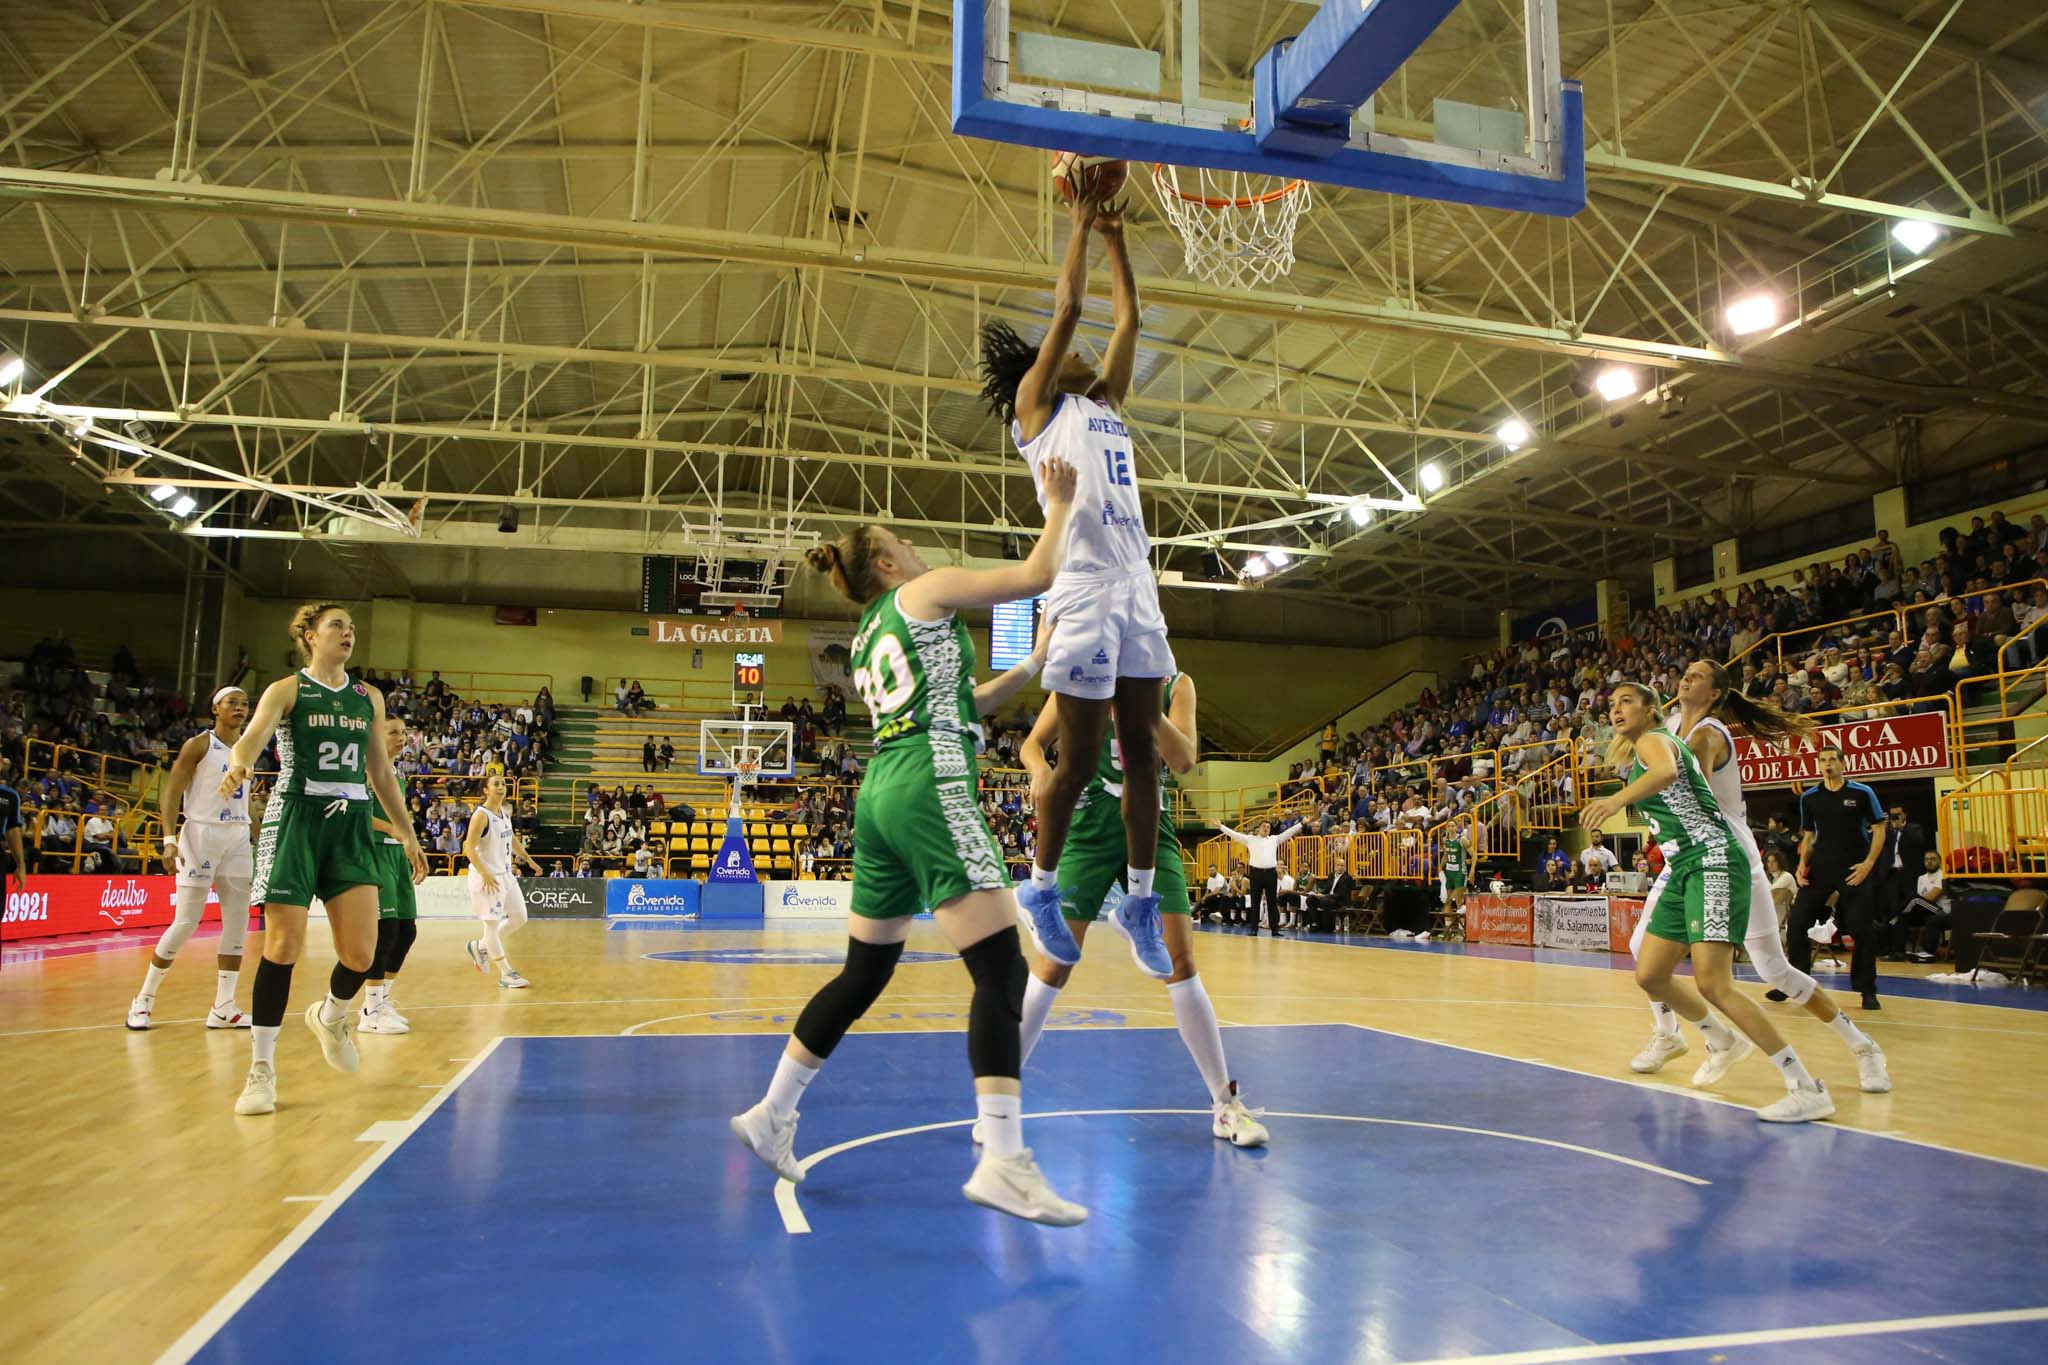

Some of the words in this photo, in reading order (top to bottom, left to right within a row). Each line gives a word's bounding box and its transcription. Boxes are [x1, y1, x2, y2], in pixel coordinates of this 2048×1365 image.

[1104, 449, 1131, 486] 12
[656, 621, 687, 643] LA
[690, 623, 774, 643] GACETA
[738, 668, 760, 684] 10
[308, 714, 335, 727] UNI
[318, 741, 359, 772] 24
[1758, 761, 1782, 780] DE
[1787, 759, 1810, 778] LA
[101, 880, 148, 907] dealba
[1555, 904, 1607, 918] Ayuntamiento
[1567, 919, 1607, 933] Salamanca
